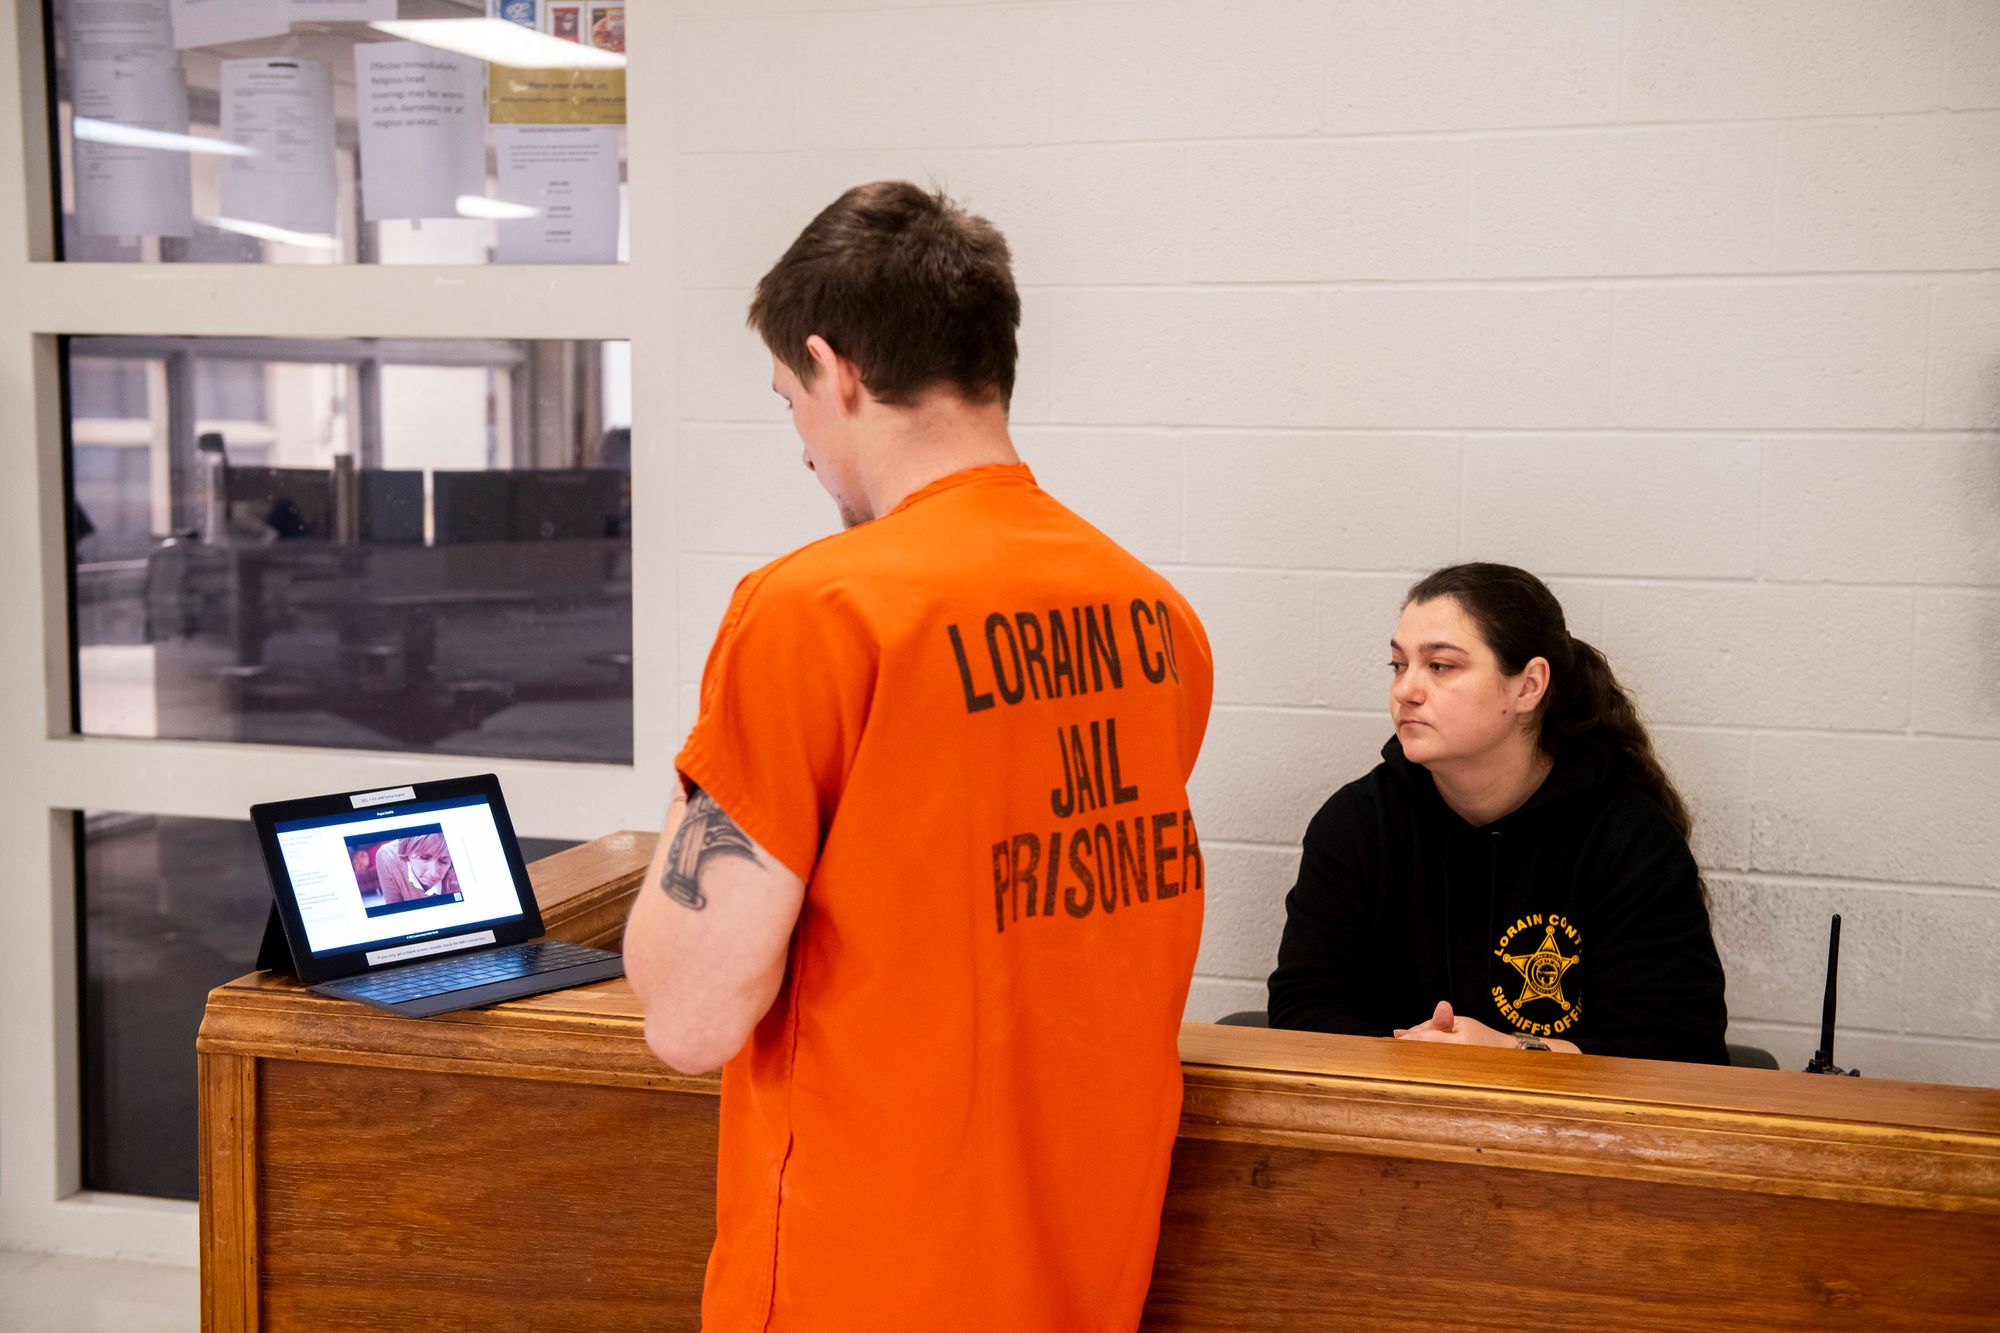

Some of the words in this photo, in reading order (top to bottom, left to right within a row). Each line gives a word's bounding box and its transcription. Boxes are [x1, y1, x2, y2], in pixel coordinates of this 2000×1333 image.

[947, 603, 1124, 714] LORAIN
[1130, 598, 1180, 685] CO
[1051, 717, 1139, 819] JAIL
[990, 808, 1203, 934] PRISONER
[1493, 913, 1543, 957] LORAIN
[1491, 985, 1551, 1036] SHERIFF'S
